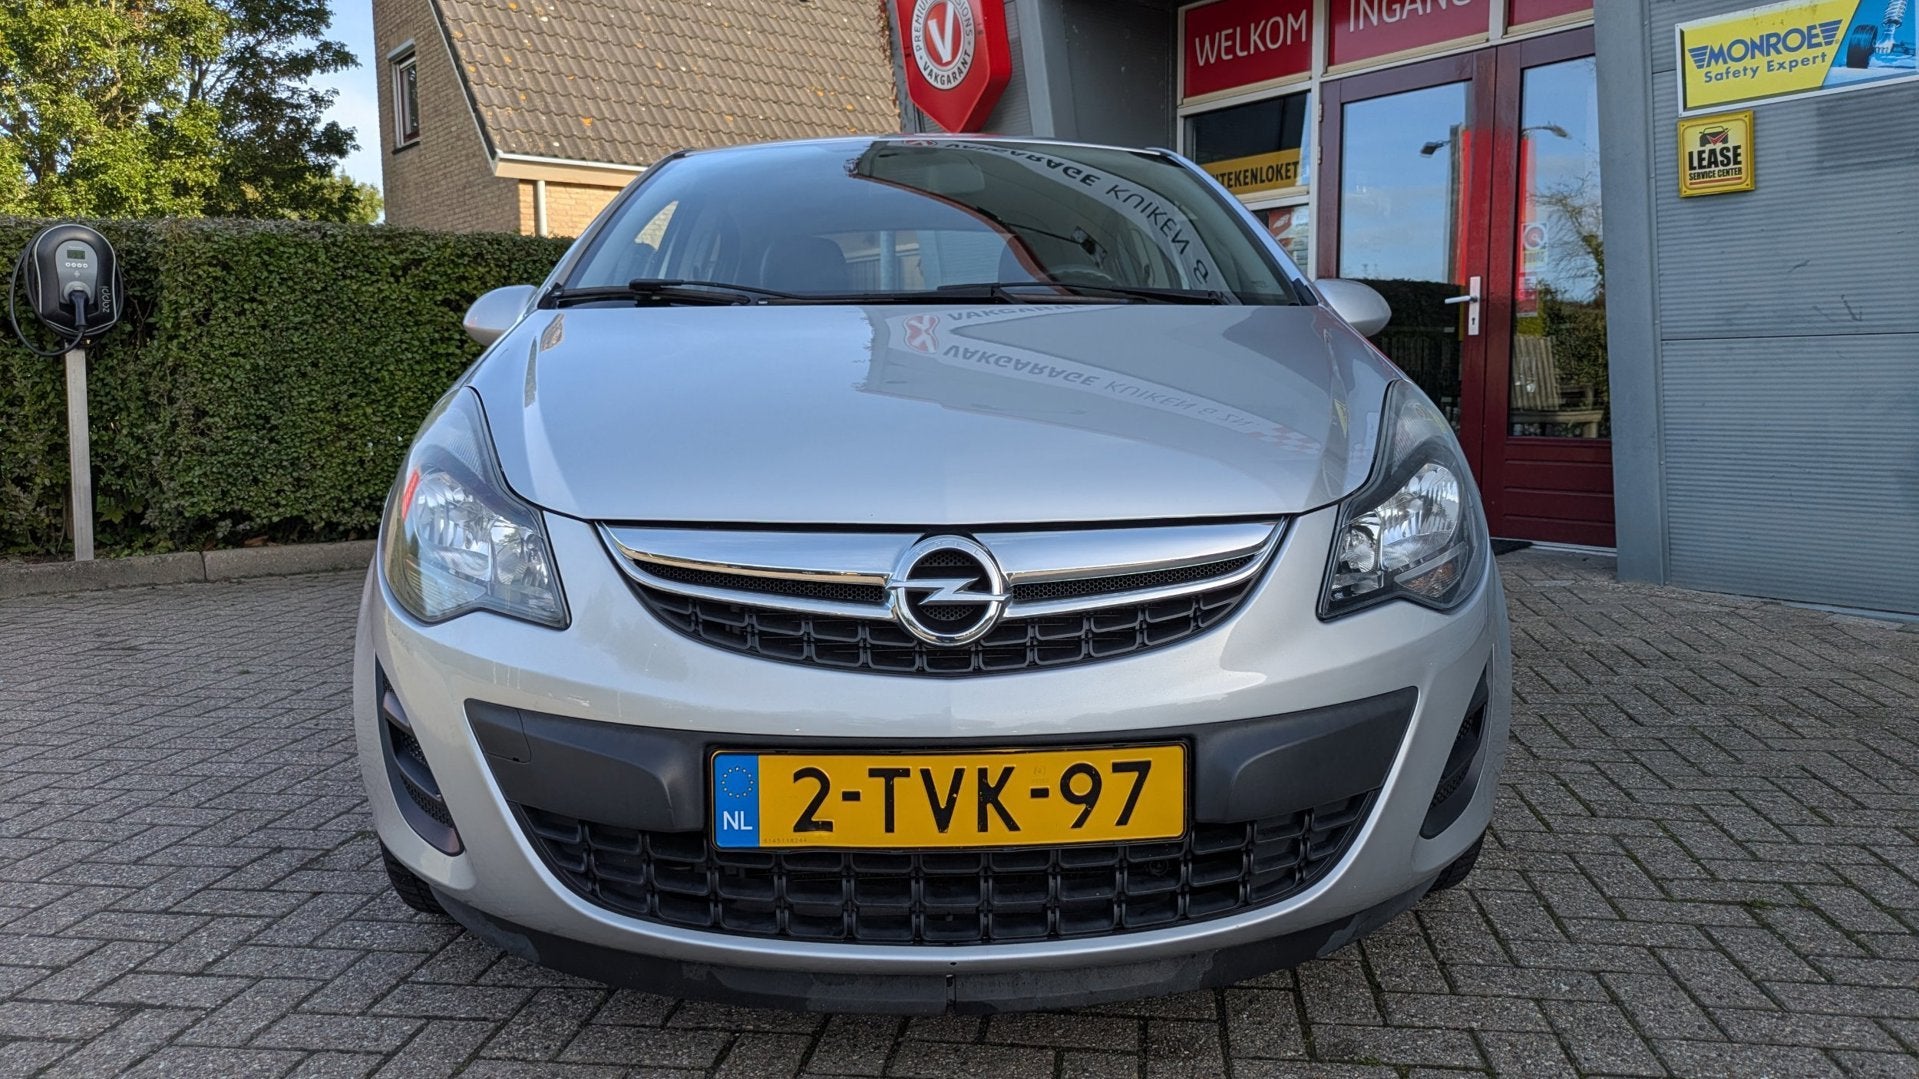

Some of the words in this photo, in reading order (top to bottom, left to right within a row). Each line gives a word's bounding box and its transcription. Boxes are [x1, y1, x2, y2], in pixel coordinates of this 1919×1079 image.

[914, 0, 932, 52] PREMIU
[1195, 9, 1307, 66] WELKOM
[1706, 24, 1823, 68] MONROE
[923, 49, 971, 86] VAKGARANT
[1704, 66, 1760, 83] Safety
[1766, 51, 1828, 73] Expert
[1688, 144, 1743, 171] LEASE
[1689, 170, 1717, 181] SERVICE
[1717, 167, 1743, 177] CENTER
[101, 286, 111, 313] zappi
[793, 760, 1152, 834] 2-TVK-97
[723, 811, 753, 831] NL
